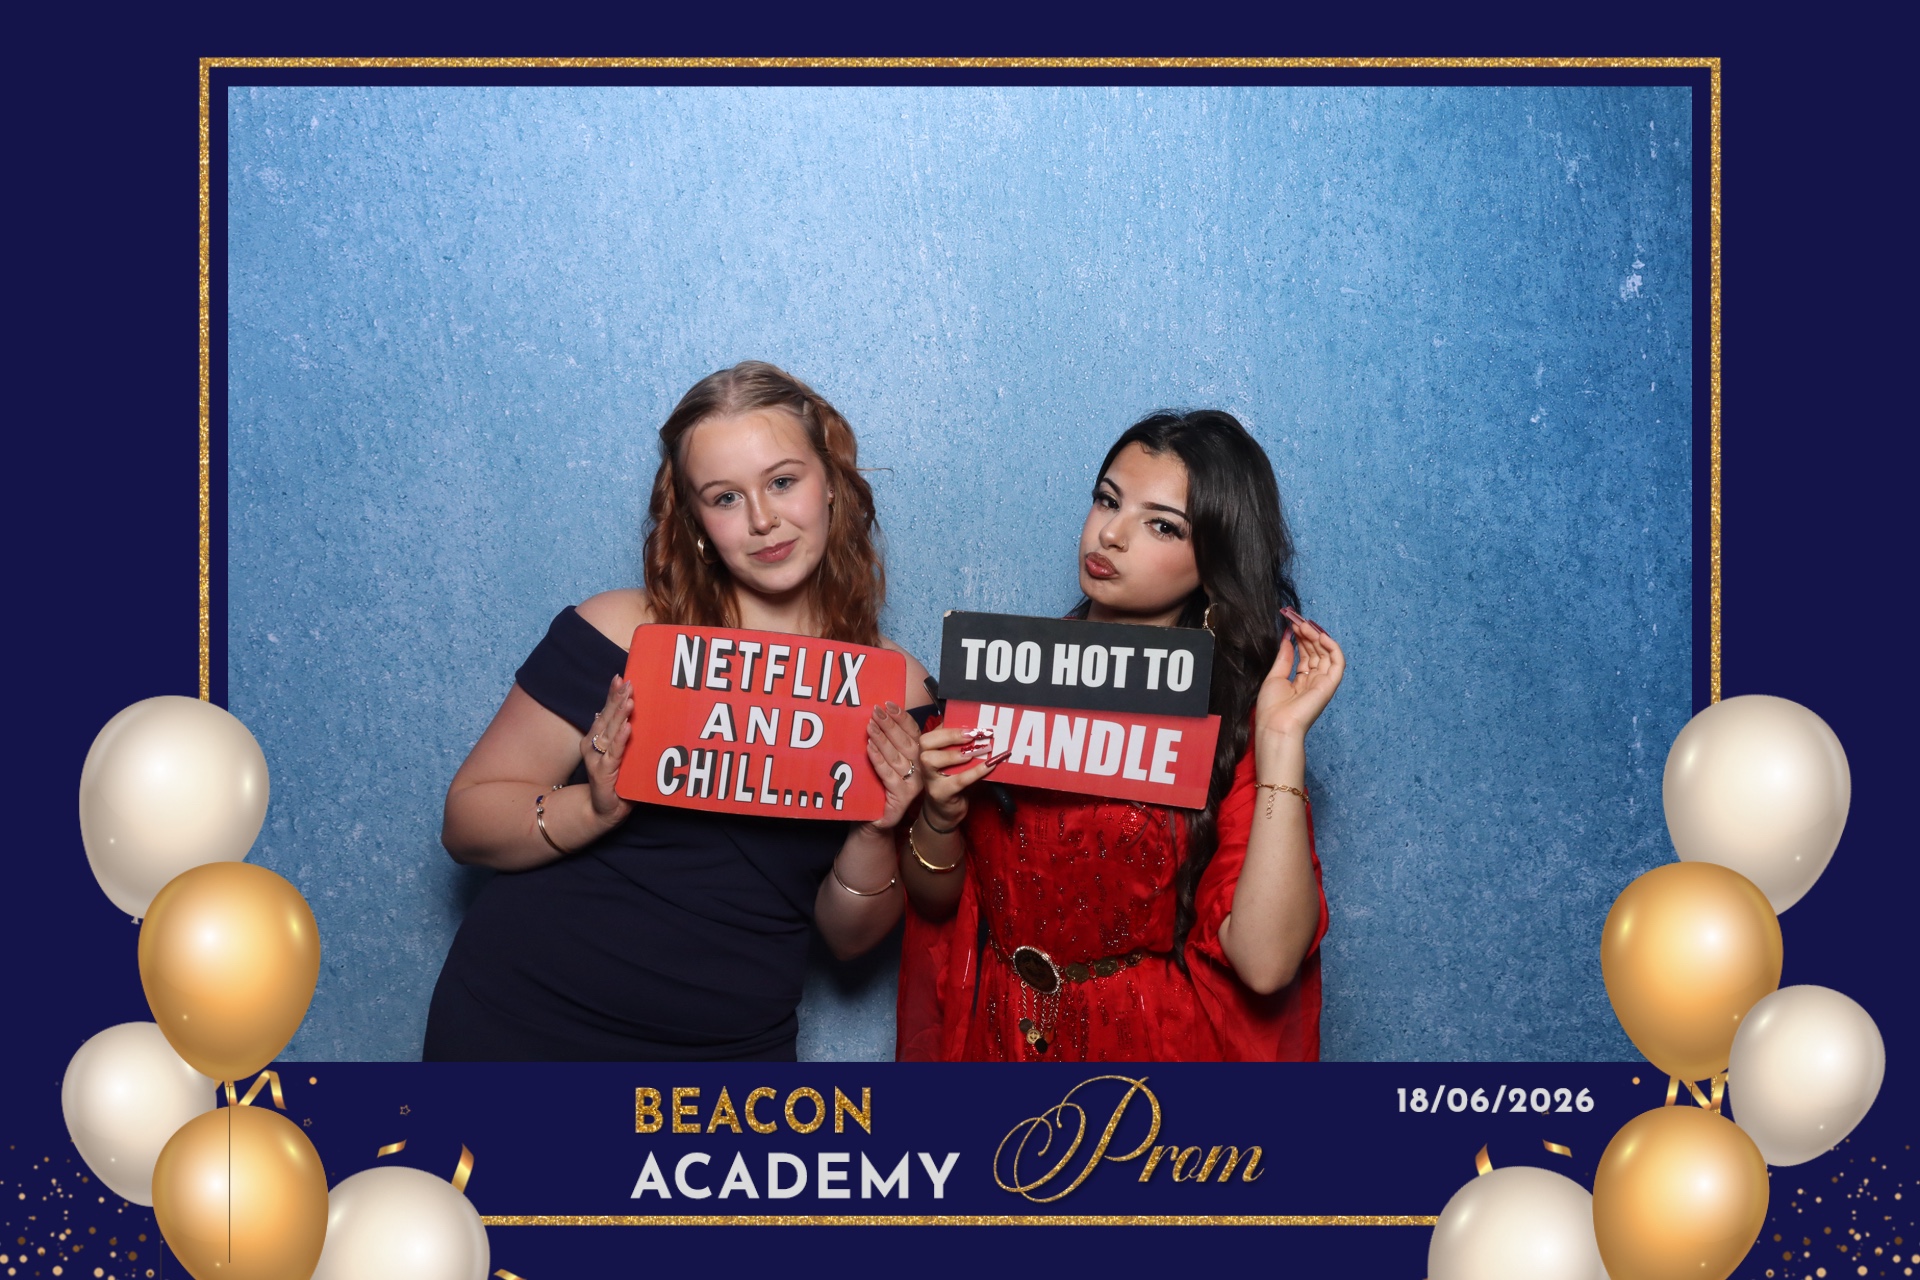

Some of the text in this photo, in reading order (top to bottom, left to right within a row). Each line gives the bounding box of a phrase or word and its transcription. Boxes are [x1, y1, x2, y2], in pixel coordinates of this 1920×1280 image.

[671, 633, 866, 706] NETFLIX
[961, 638, 1195, 692] TOO HOT TO
[700, 702, 824, 749] AND
[973, 704, 1183, 785] HANDLE
[656, 745, 853, 811] CHILL...?
